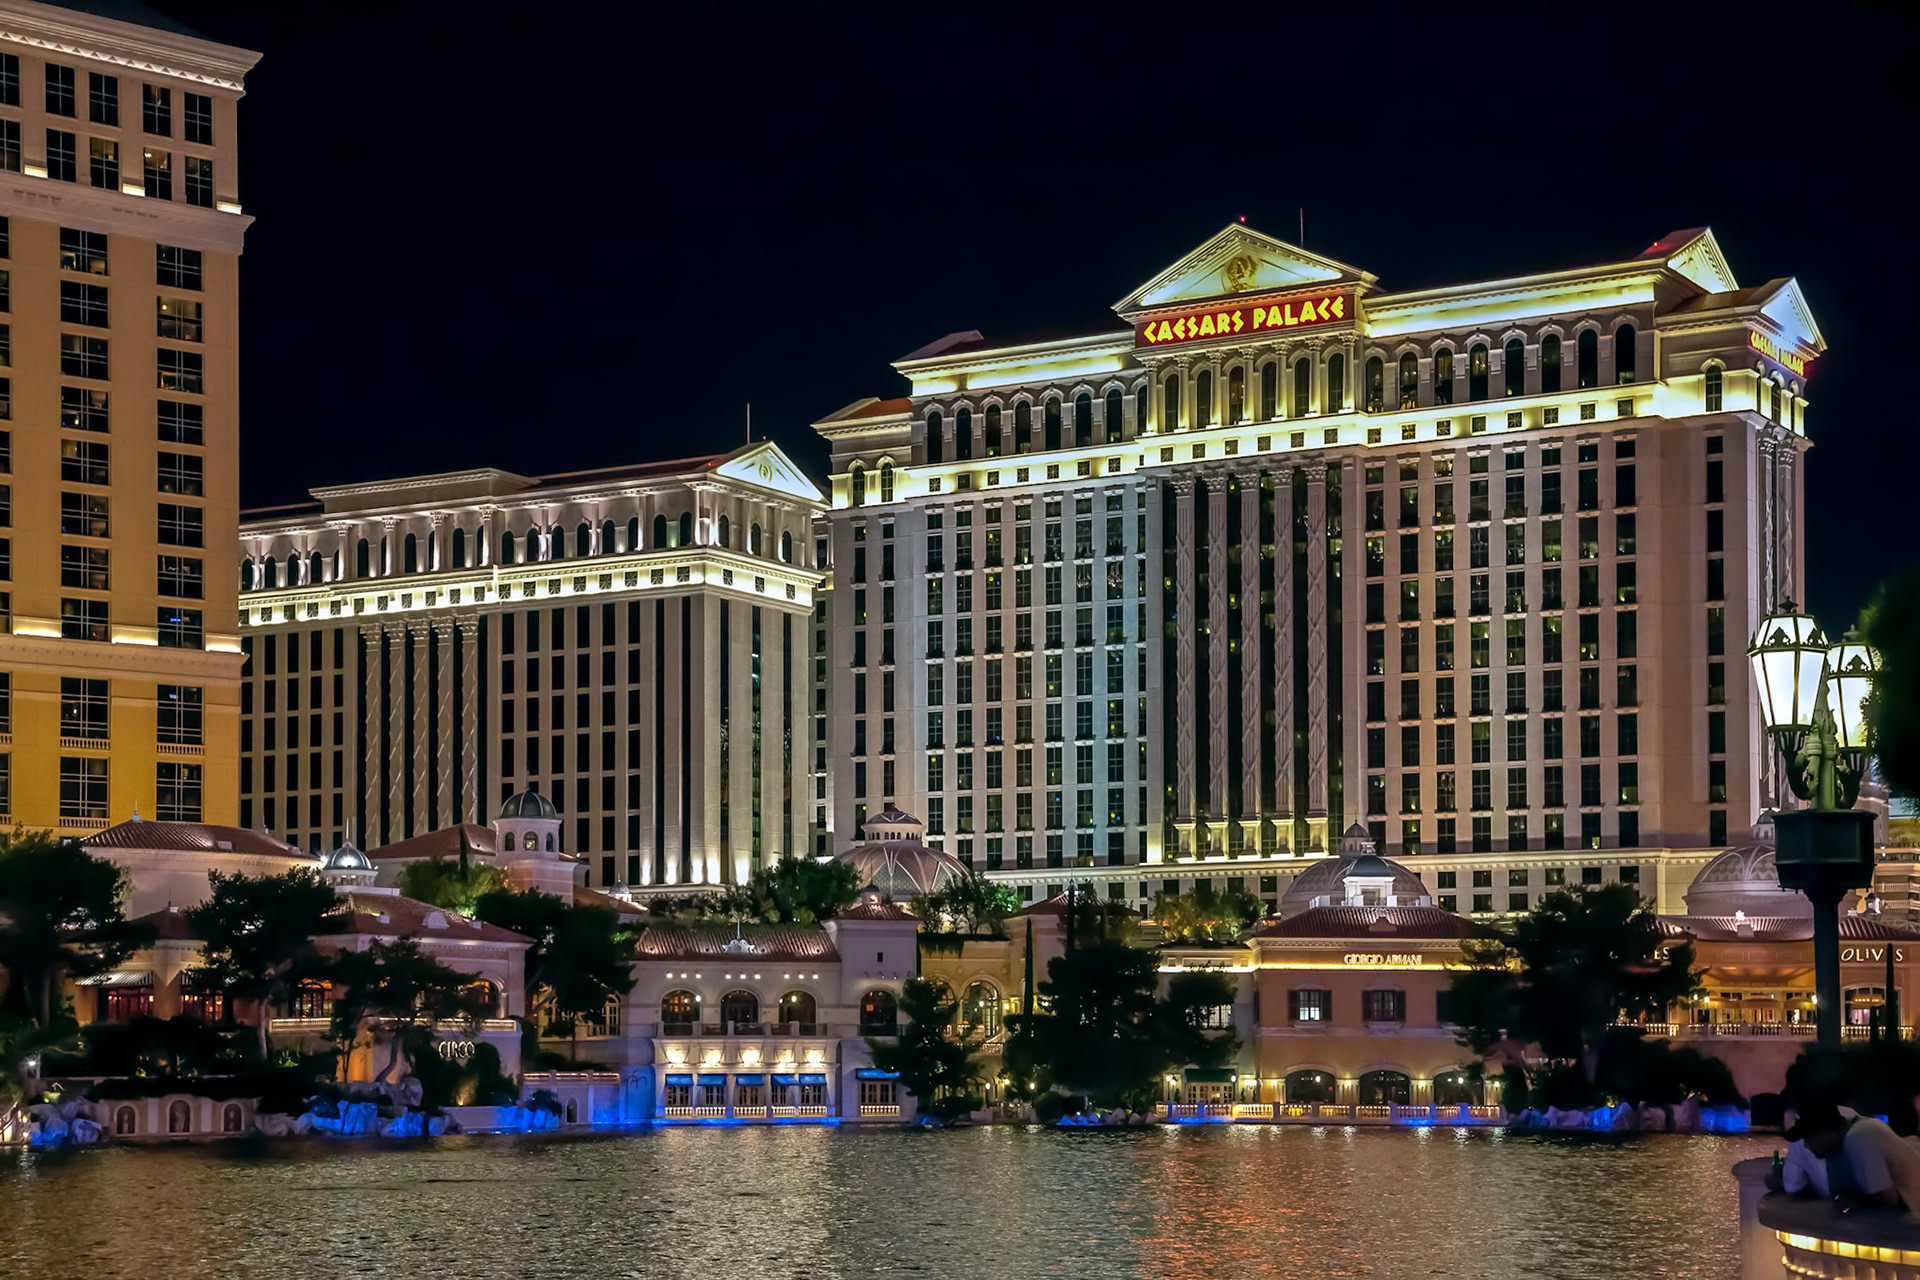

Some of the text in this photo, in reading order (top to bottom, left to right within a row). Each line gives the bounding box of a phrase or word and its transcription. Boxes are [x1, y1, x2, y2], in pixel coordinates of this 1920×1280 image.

[1143, 295, 1345, 344] CAESARS PALACE
[1344, 953, 1423, 965] GIORGIO ARMANI
[1840, 948, 1904, 962] OLIVS
[438, 1040, 476, 1059] CIRCO
